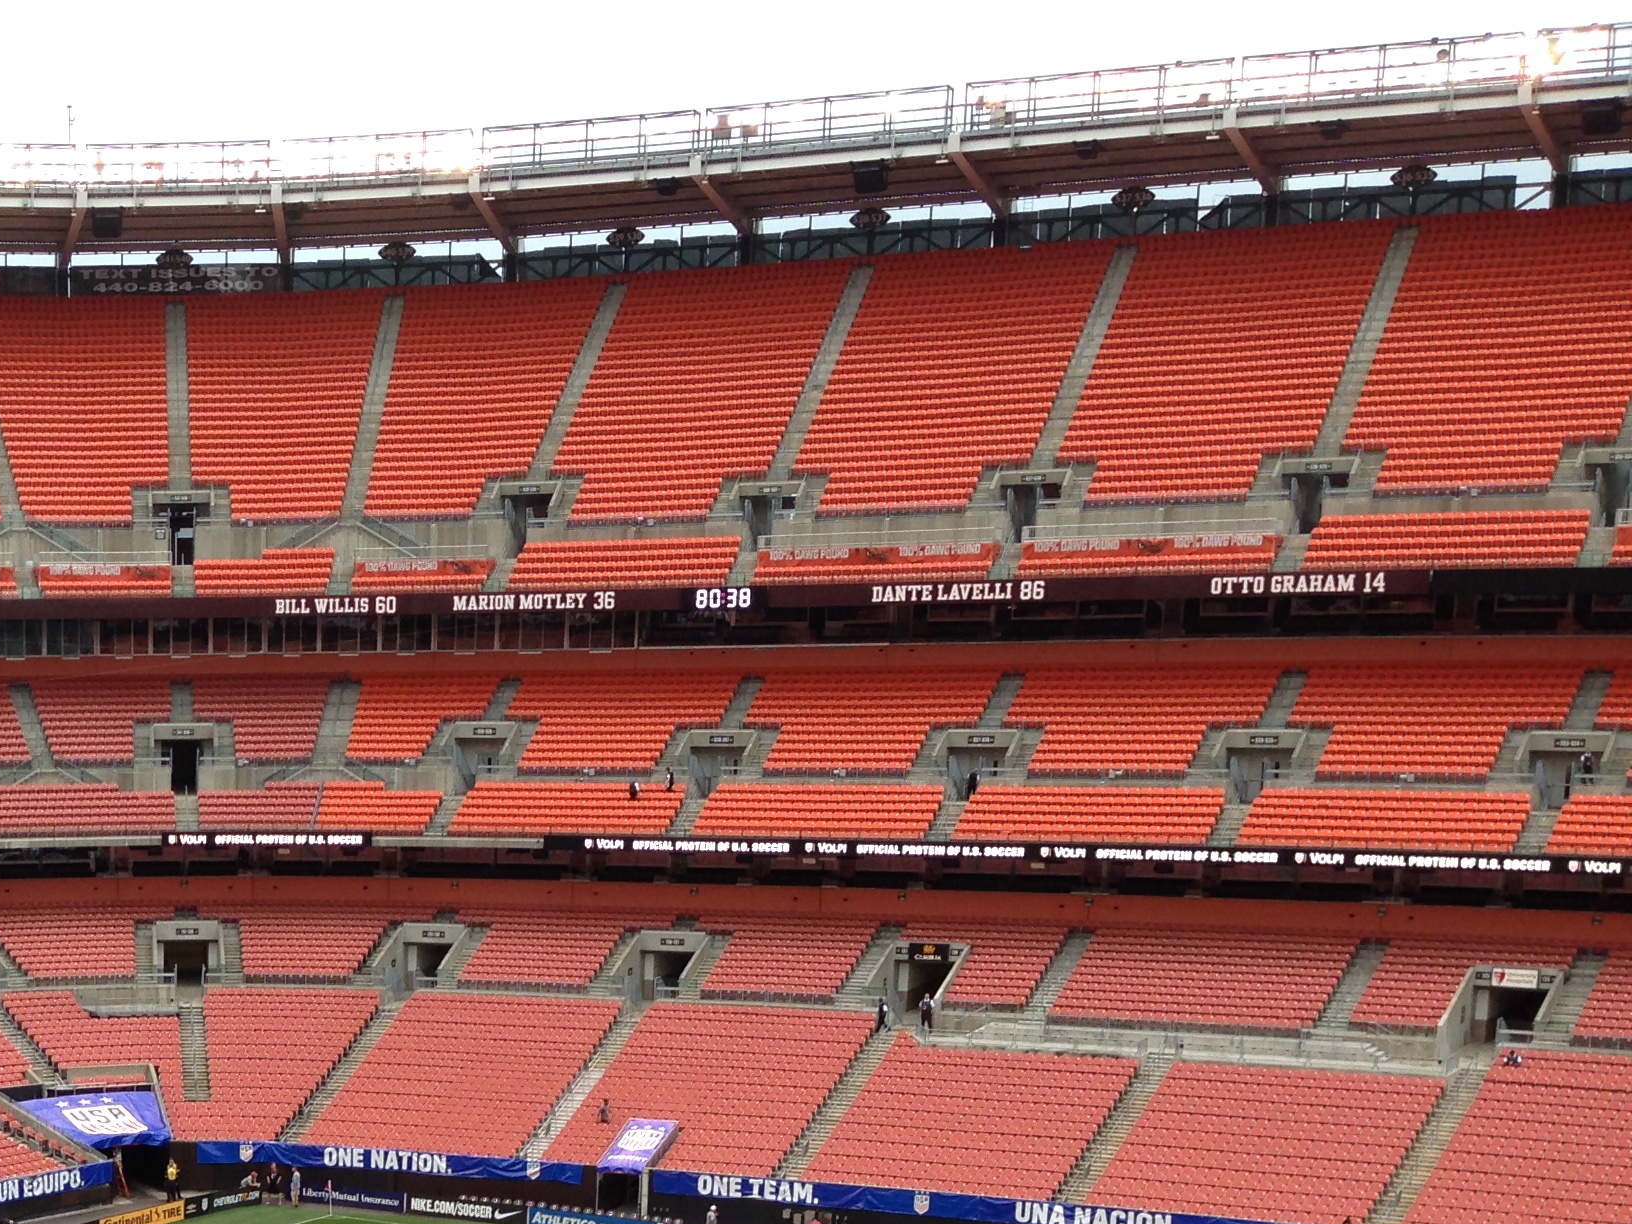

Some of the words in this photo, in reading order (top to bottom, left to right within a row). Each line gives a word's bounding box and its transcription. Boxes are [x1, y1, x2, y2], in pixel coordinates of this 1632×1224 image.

[79, 268, 144, 281] TEXT
[247, 265, 279, 278] TO
[871, 585, 932, 602] DANTE
[936, 583, 1012, 601] LAVELLI
[1019, 580, 1045, 600] 86
[1210, 577, 1263, 596] OTTO
[1270, 574, 1355, 593] GRAHAM
[276, 598, 311, 614] BILL
[315, 596, 369, 614] WILLIS
[375, 596, 396, 614] 60
[452, 594, 515, 612] MARION
[519, 592, 587, 610] MOTLEY
[593, 591, 615, 610] 36
[695, 588, 752, 609] 80:38
[69, 1104, 128, 1126] USA
[324, 1147, 364, 1168] ONE
[370, 1150, 452, 1175] NATION.
[697, 1175, 742, 1197] ONE
[748, 1180, 818, 1204] TEAM.
[162, 1206, 182, 1220] TIRE
[411, 1198, 492, 1219] NIKE.COM/SOCCER
